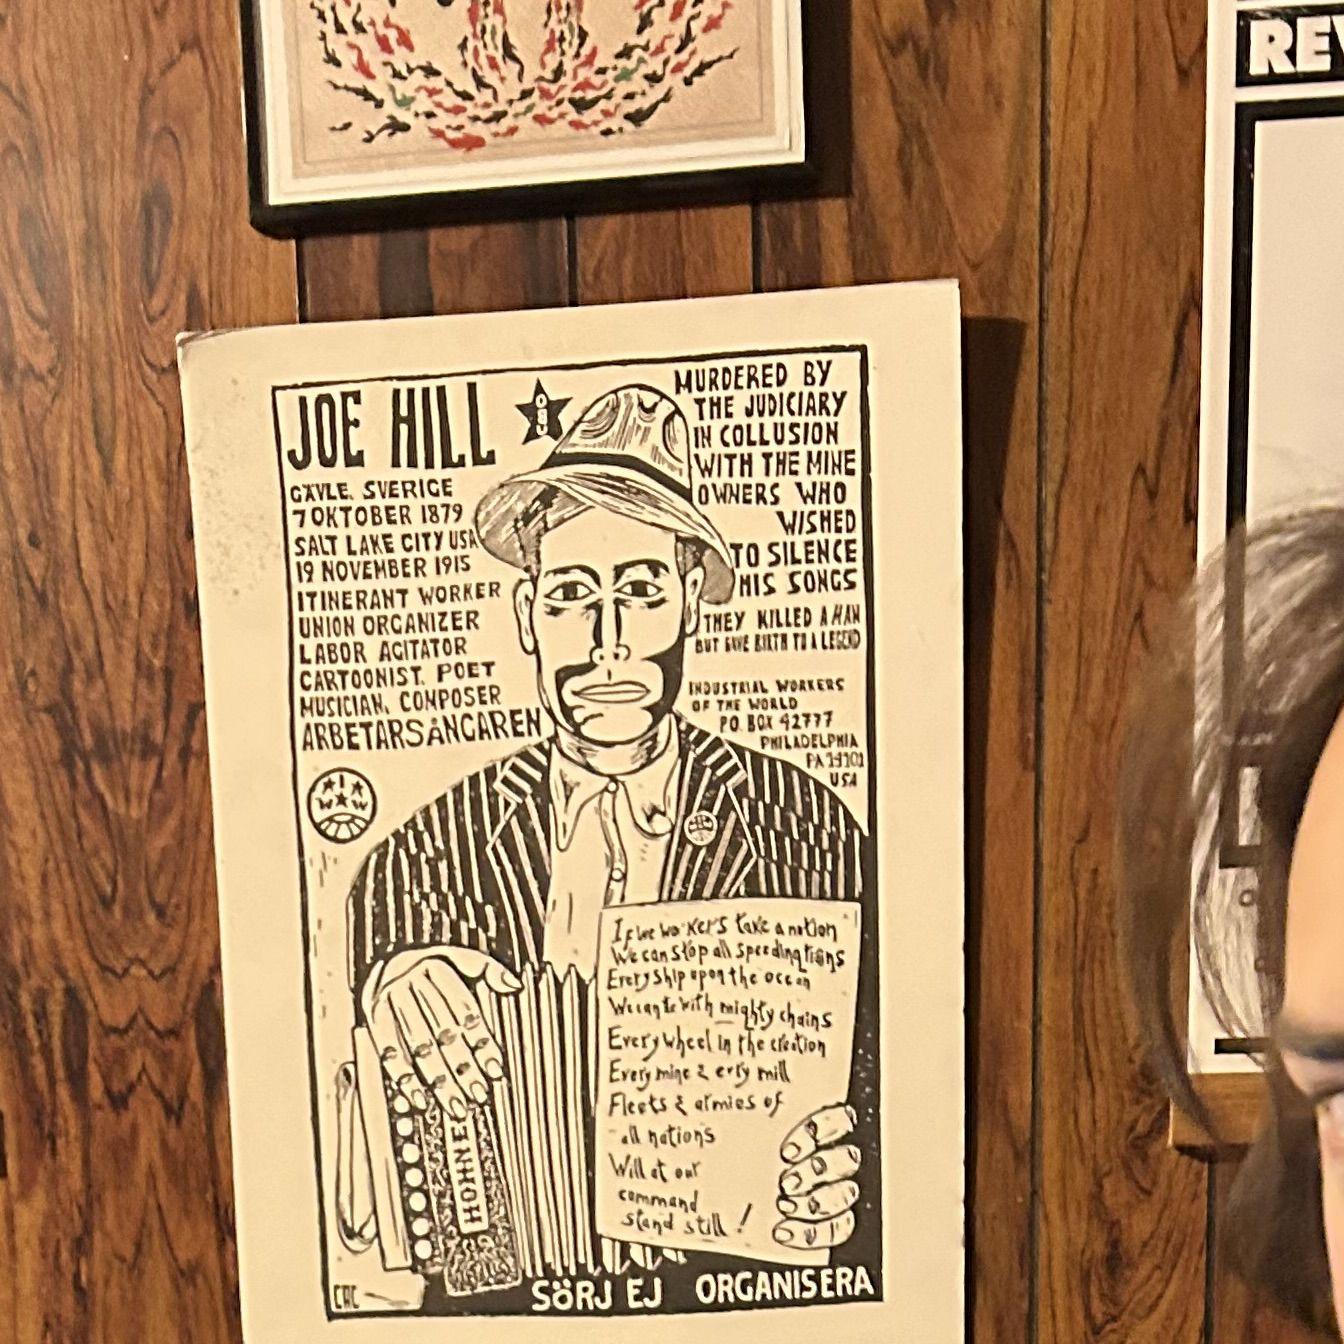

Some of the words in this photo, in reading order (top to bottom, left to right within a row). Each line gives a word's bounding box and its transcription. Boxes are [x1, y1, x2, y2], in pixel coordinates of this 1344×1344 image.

[674, 362, 787, 395] MURDERED
[804, 360, 832, 386] BY
[694, 395, 734, 420] THE
[745, 391, 847, 418] JUDICIARY
[287, 390, 365, 470] JOE
[391, 382, 496, 469] HILL
[694, 426, 711, 448] IN
[720, 421, 838, 447] COLLUSION
[694, 453, 753, 478] WITH
[762, 451, 799, 477] THE
[807, 449, 856, 476] MINE
[363, 478, 452, 500] SVERIGE
[698, 483, 780, 505] OWNERS
[795, 482, 846, 504] WHO
[293, 510, 306, 528] 7
[312, 505, 411, 528] OKTOBER
[422, 503, 463, 524] 1879
[776, 509, 856, 536] WISHED
[295, 535, 336, 556] SALT
[347, 533, 393, 555] LAKE
[401, 531, 443, 552] CITY
[449, 529, 479, 549] USA
[729, 542, 759, 568] TO
[767, 539, 857, 568] SILENCE
[297, 561, 313, 582] 19
[322, 558, 426, 581] NOVEMBER
[436, 554, 471, 575] 1915
[298, 589, 408, 611] ITINERANT
[419, 581, 501, 606] WORKER
[739, 573, 776, 597] HIS
[787, 568, 857, 595] SONGS
[299, 615, 355, 638] UNION
[363, 610, 479, 636] ORGANIZER
[703, 611, 745, 633] THEY
[757, 607, 812, 629] KILLED
[820, 605, 827, 626] A
[300, 641, 367, 665] LABOR
[379, 637, 467, 662] AGITATOR
[437, 661, 496, 683] POET
[400, 685, 501, 712] COMPOSER
[688, 680, 768, 696] INDUSTRIAL
[776, 677, 845, 693] WORKERS
[692, 700, 709, 712] OF
[717, 699, 741, 711] THE
[748, 697, 798, 710] WORLD
[303, 707, 541, 751] ARBETARSÅNGAREN
[747, 714, 772, 733] BOX
[780, 710, 833, 731] 42777
[760, 733, 859, 750] PHILADELPHIA
[807, 752, 824, 769] PA
[830, 772, 857, 788] USA
[659, 916, 728, 939] wokers
[736, 911, 770, 935] take
[642, 948, 668, 963] can
[713, 938, 732, 959] all
[653, 966, 685, 992] ship
[728, 964, 758, 990] the
[678, 992, 713, 1018] with
[720, 998, 775, 1031] mighty
[780, 1001, 833, 1032] chains
[608, 1025, 659, 1062] Every
[662, 1025, 712, 1058] wheel
[738, 1031, 765, 1058] the
[609, 1058, 651, 1092] Every
[757, 1059, 791, 1084] mill
[609, 1091, 667, 1117] Fleets
[763, 1091, 783, 1118] of
[621, 1124, 641, 1145] all
[648, 1123, 716, 1149] nations
[608, 1152, 648, 1180] Will
[650, 1158, 668, 1183] at
[675, 1161, 701, 1179] our
[618, 1189, 699, 1213] command
[621, 1208, 674, 1236] stand
[531, 1278, 612, 1311] SÖRJ
[626, 1278, 663, 1309] EJ
[695, 1266, 874, 1304] ORGANISERA
